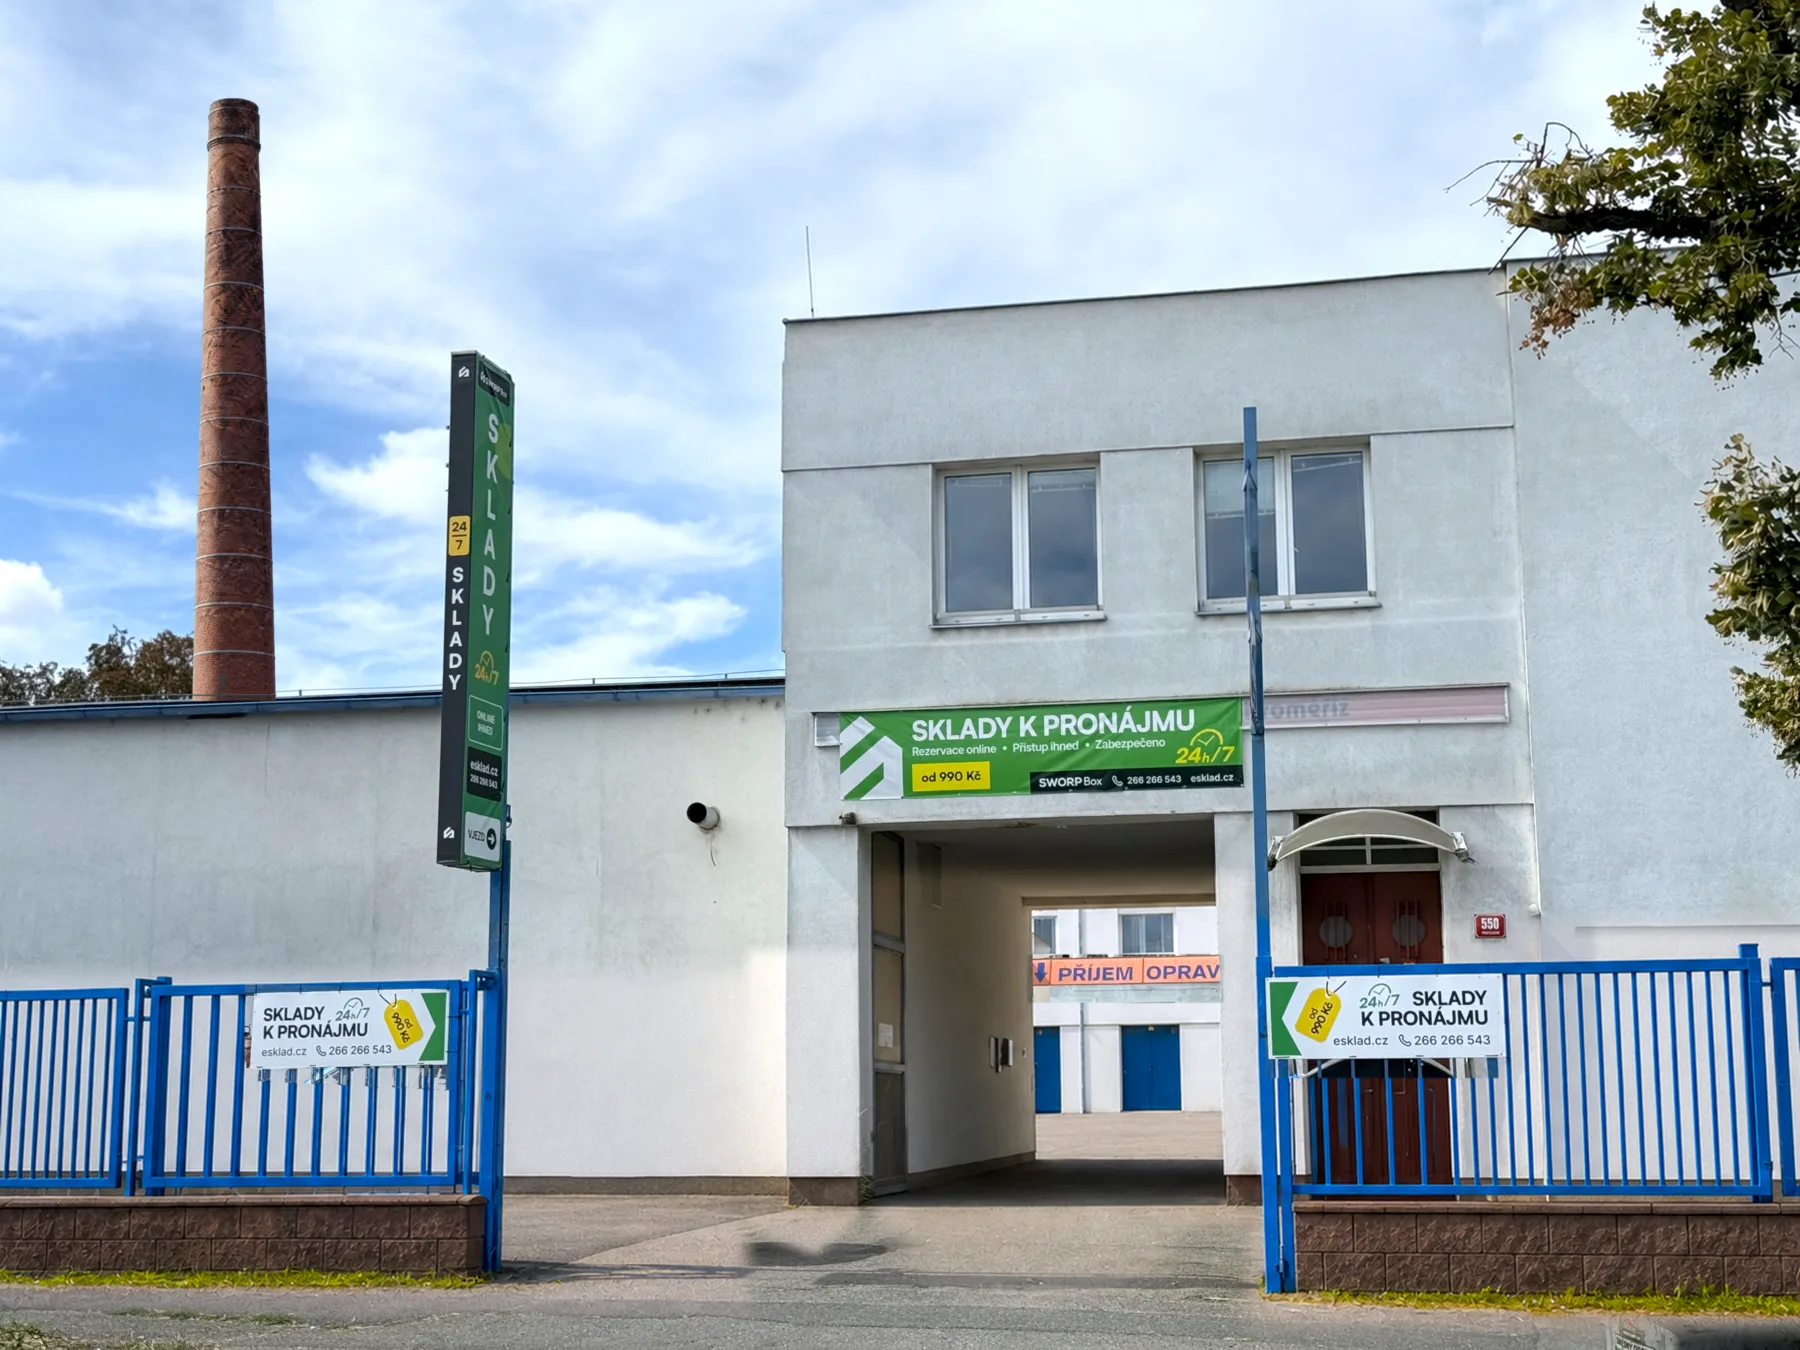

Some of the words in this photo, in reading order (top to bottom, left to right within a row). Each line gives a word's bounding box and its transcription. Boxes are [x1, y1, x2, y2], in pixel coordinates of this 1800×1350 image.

[452, 522, 467, 532] 24
[482, 413, 498, 636] SKLADY
[456, 540, 462, 550] 7
[448, 567, 464, 690] SKLADY
[912, 716, 1012, 742] SKLADY
[1020, 716, 1037, 738] K
[1044, 706, 1194, 736] PRONÁJMU
[912, 746, 964, 756] Rezervace
[966, 744, 996, 754] online
[1013, 742, 1048, 754] Přístup
[1051, 740, 1078, 751] ihned
[1095, 738, 1166, 750] Zabezpečeno
[470, 760, 498, 776] esklad.cz
[921, 772, 936, 782] od
[940, 771, 962, 782] 990
[966, 770, 981, 781] Kč
[1038, 776, 1082, 788] SWORP
[1084, 776, 1102, 786] Box
[1127, 776, 1144, 784] 266
[1146, 776, 1162, 784] 266
[1165, 775, 1182, 783] 543
[1190, 774, 1234, 783] esklad.cz
[468, 829, 486, 842] VJEZD
[1481, 918, 1500, 930] 550
[1058, 964, 1132, 981] PŘÍJEM
[1146, 964, 1219, 980] OPRAV
[1412, 990, 1488, 1006] SKLADY
[263, 1006, 325, 1022] SKLADY
[1309, 1007, 1318, 1020] od
[1310, 1015, 1326, 1034] 990
[1320, 1001, 1333, 1016] Kč
[1361, 1011, 1374, 1026] K
[1379, 1006, 1488, 1026] PRONÁJMU
[392, 1012, 404, 1030] 990
[400, 1030, 411, 1044] Kč
[404, 1018, 413, 1028] od
[263, 1025, 274, 1040] K
[278, 1020, 368, 1039] PRONÁJMU
[1334, 1036, 1388, 1046] esklad.cz
[1414, 1036, 1436, 1045] 266
[1441, 1035, 1464, 1045] 266
[1468, 1034, 1490, 1044] 543
[262, 1047, 307, 1057] esklad.cz
[328, 1046, 349, 1056] 266
[351, 1046, 370, 1055] 266
[372, 1044, 392, 1054] 543
